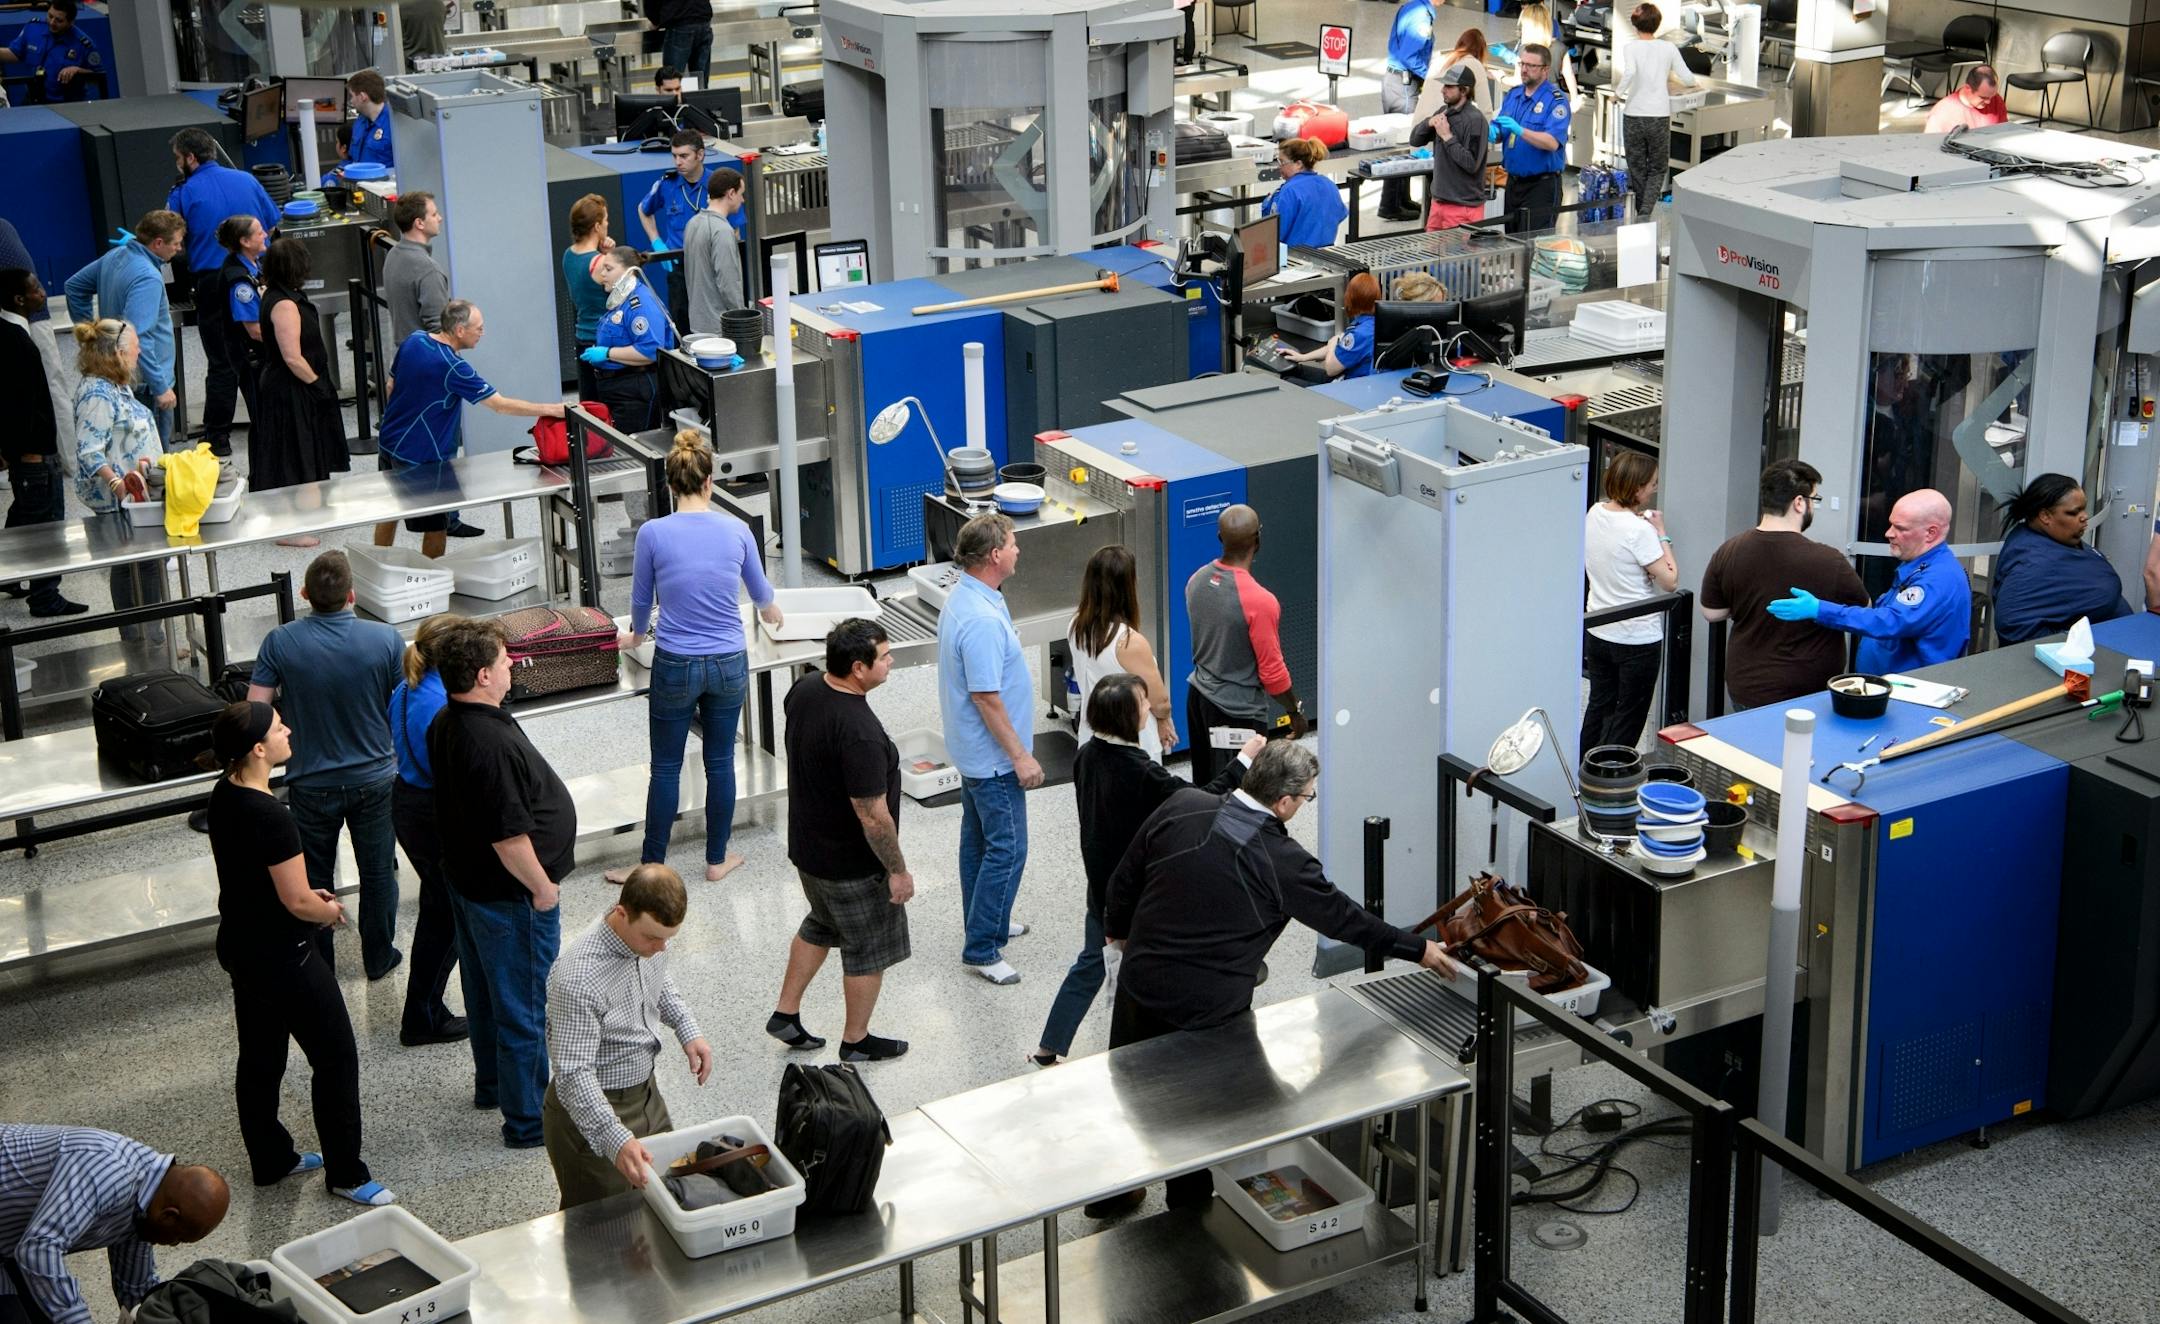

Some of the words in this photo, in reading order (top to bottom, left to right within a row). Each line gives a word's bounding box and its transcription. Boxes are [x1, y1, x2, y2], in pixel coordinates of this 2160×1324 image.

[1323, 35, 1347, 52] STOP
[1730, 250, 1779, 275] ProVision
[1759, 274, 1780, 289] ATD
[410, 601, 430, 613] X07
[938, 774, 959, 786] S55
[1309, 1217, 1338, 1233] S42
[400, 1301, 436, 1324] X13
